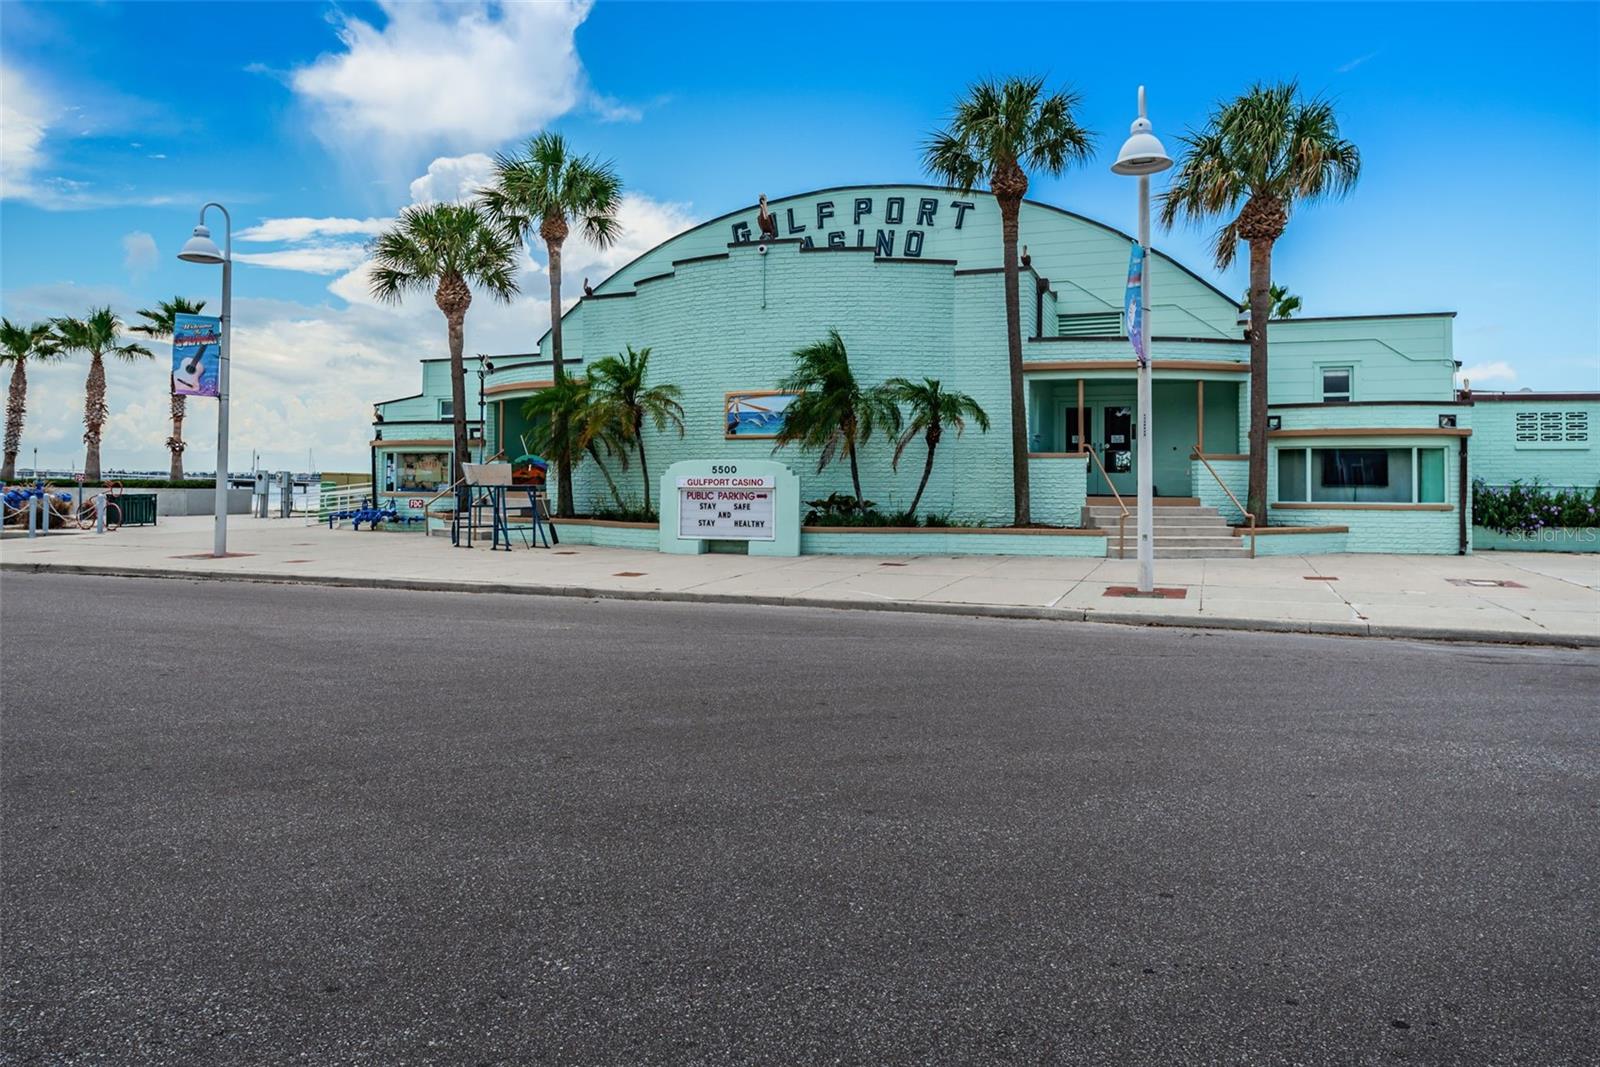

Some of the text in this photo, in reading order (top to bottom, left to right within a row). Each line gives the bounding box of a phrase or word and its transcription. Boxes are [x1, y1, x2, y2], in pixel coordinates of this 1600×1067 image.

[712, 465, 737, 474] 5500
[687, 478, 764, 487] GULFPORT CASINO
[686, 491, 756, 501] PUBLIC PARKING
[410, 500, 423, 508] FDC
[733, 502, 751, 511] SAFE
[717, 511, 732, 519] AND
[698, 519, 765, 528] STAY HEALTHY
